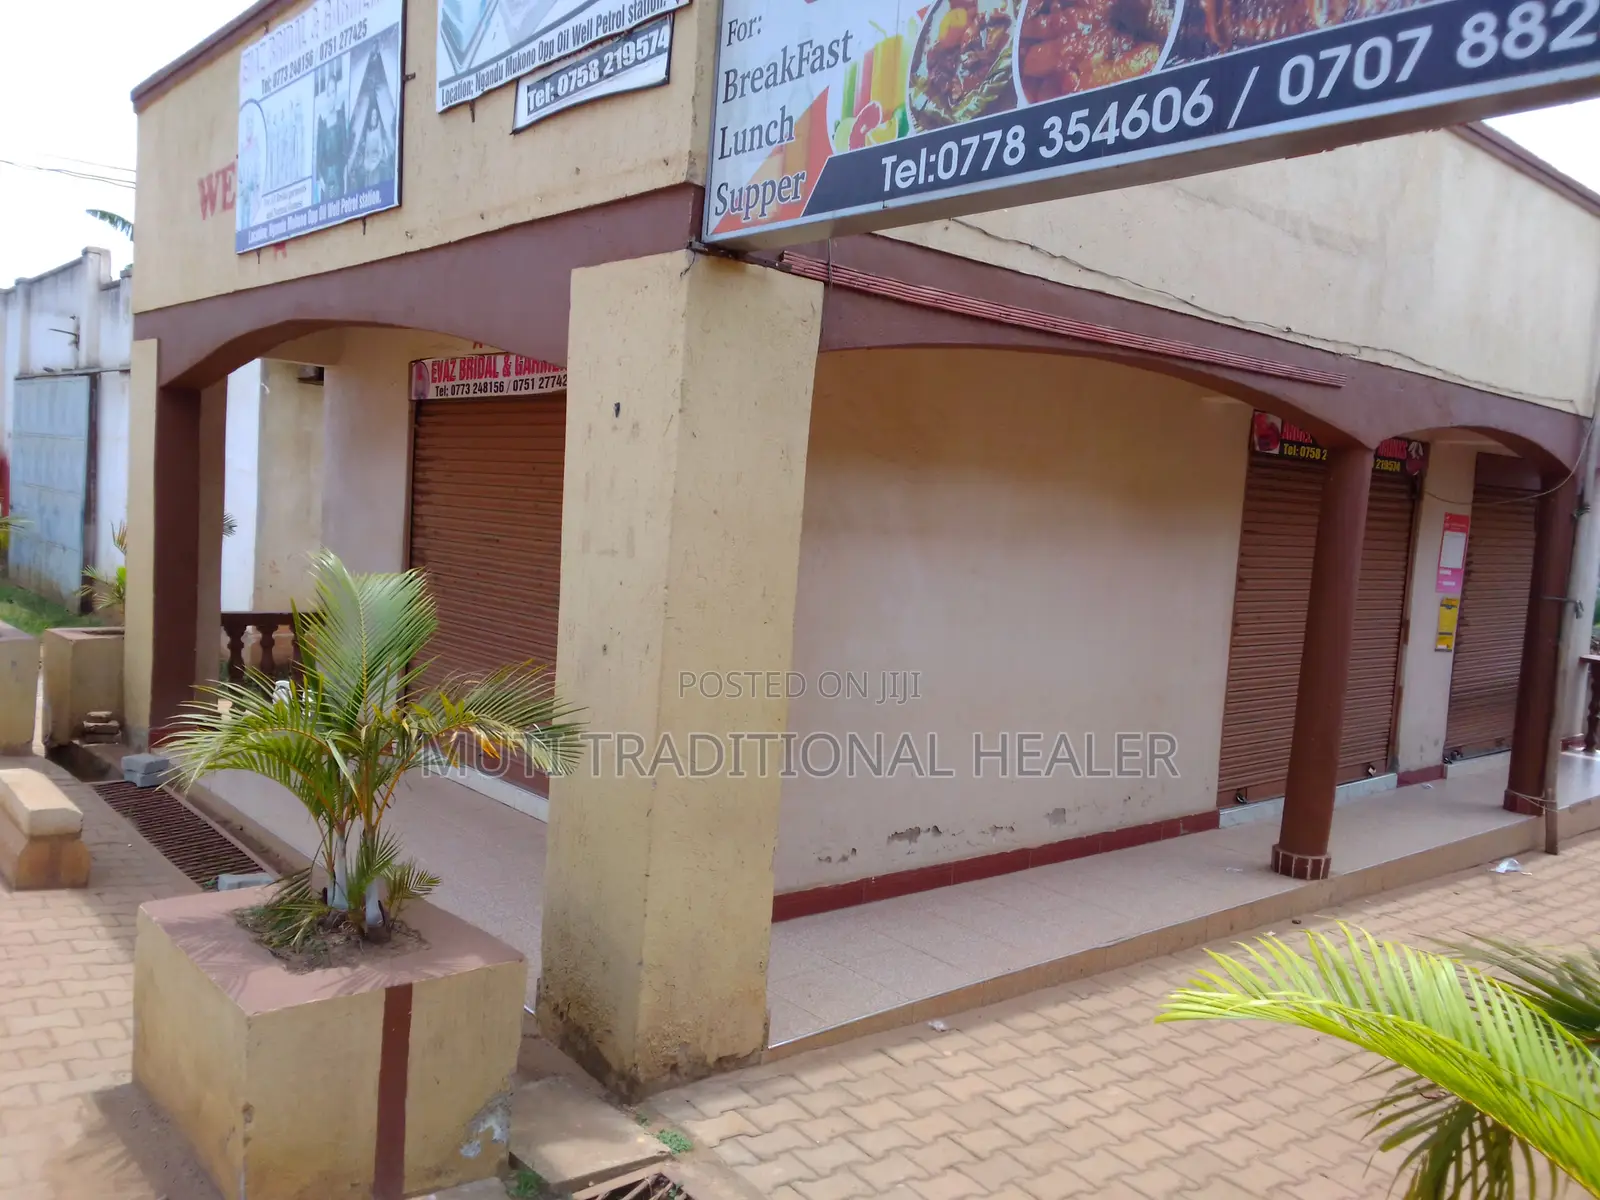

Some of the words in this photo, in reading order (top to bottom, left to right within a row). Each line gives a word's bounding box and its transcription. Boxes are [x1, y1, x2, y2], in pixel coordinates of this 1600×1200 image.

[273, 64, 288, 88] 0773
[320, 36, 337, 61] 0751
[339, 18, 368, 49] 277425
[475, 62, 504, 92] Ngandu
[505, 47, 536, 76] Mukono
[538, 41, 555, 62] Opp
[557, 29, 570, 53] Oil
[572, 21, 593, 45] Well
[596, 9, 626, 38] Petrol
[726, 14, 762, 47] For:
[527, 86, 555, 112] Tel:
[557, 58, 600, 97] 0758
[603, 27, 670, 76] 219574
[722, 29, 854, 105] BreakFast
[881, 125, 1026, 192] Tel:0778
[1038, 79, 1215, 160] 354606
[1227, 66, 1260, 130] /
[1278, 25, 1433, 107] 0707
[1456, 0, 1600, 70] 882
[718, 104, 795, 161] Lunch
[714, 169, 808, 221] Supper
[431, 359, 457, 384] EVAZ
[459, 355, 499, 381] BRIDAL
[502, 354, 512, 378] &
[450, 384, 470, 396] 0773
[472, 381, 505, 394] 248156
[513, 378, 535, 392] 0751
[1283, 443, 1299, 457] Tel:
[1300, 446, 1321, 460] 0758
